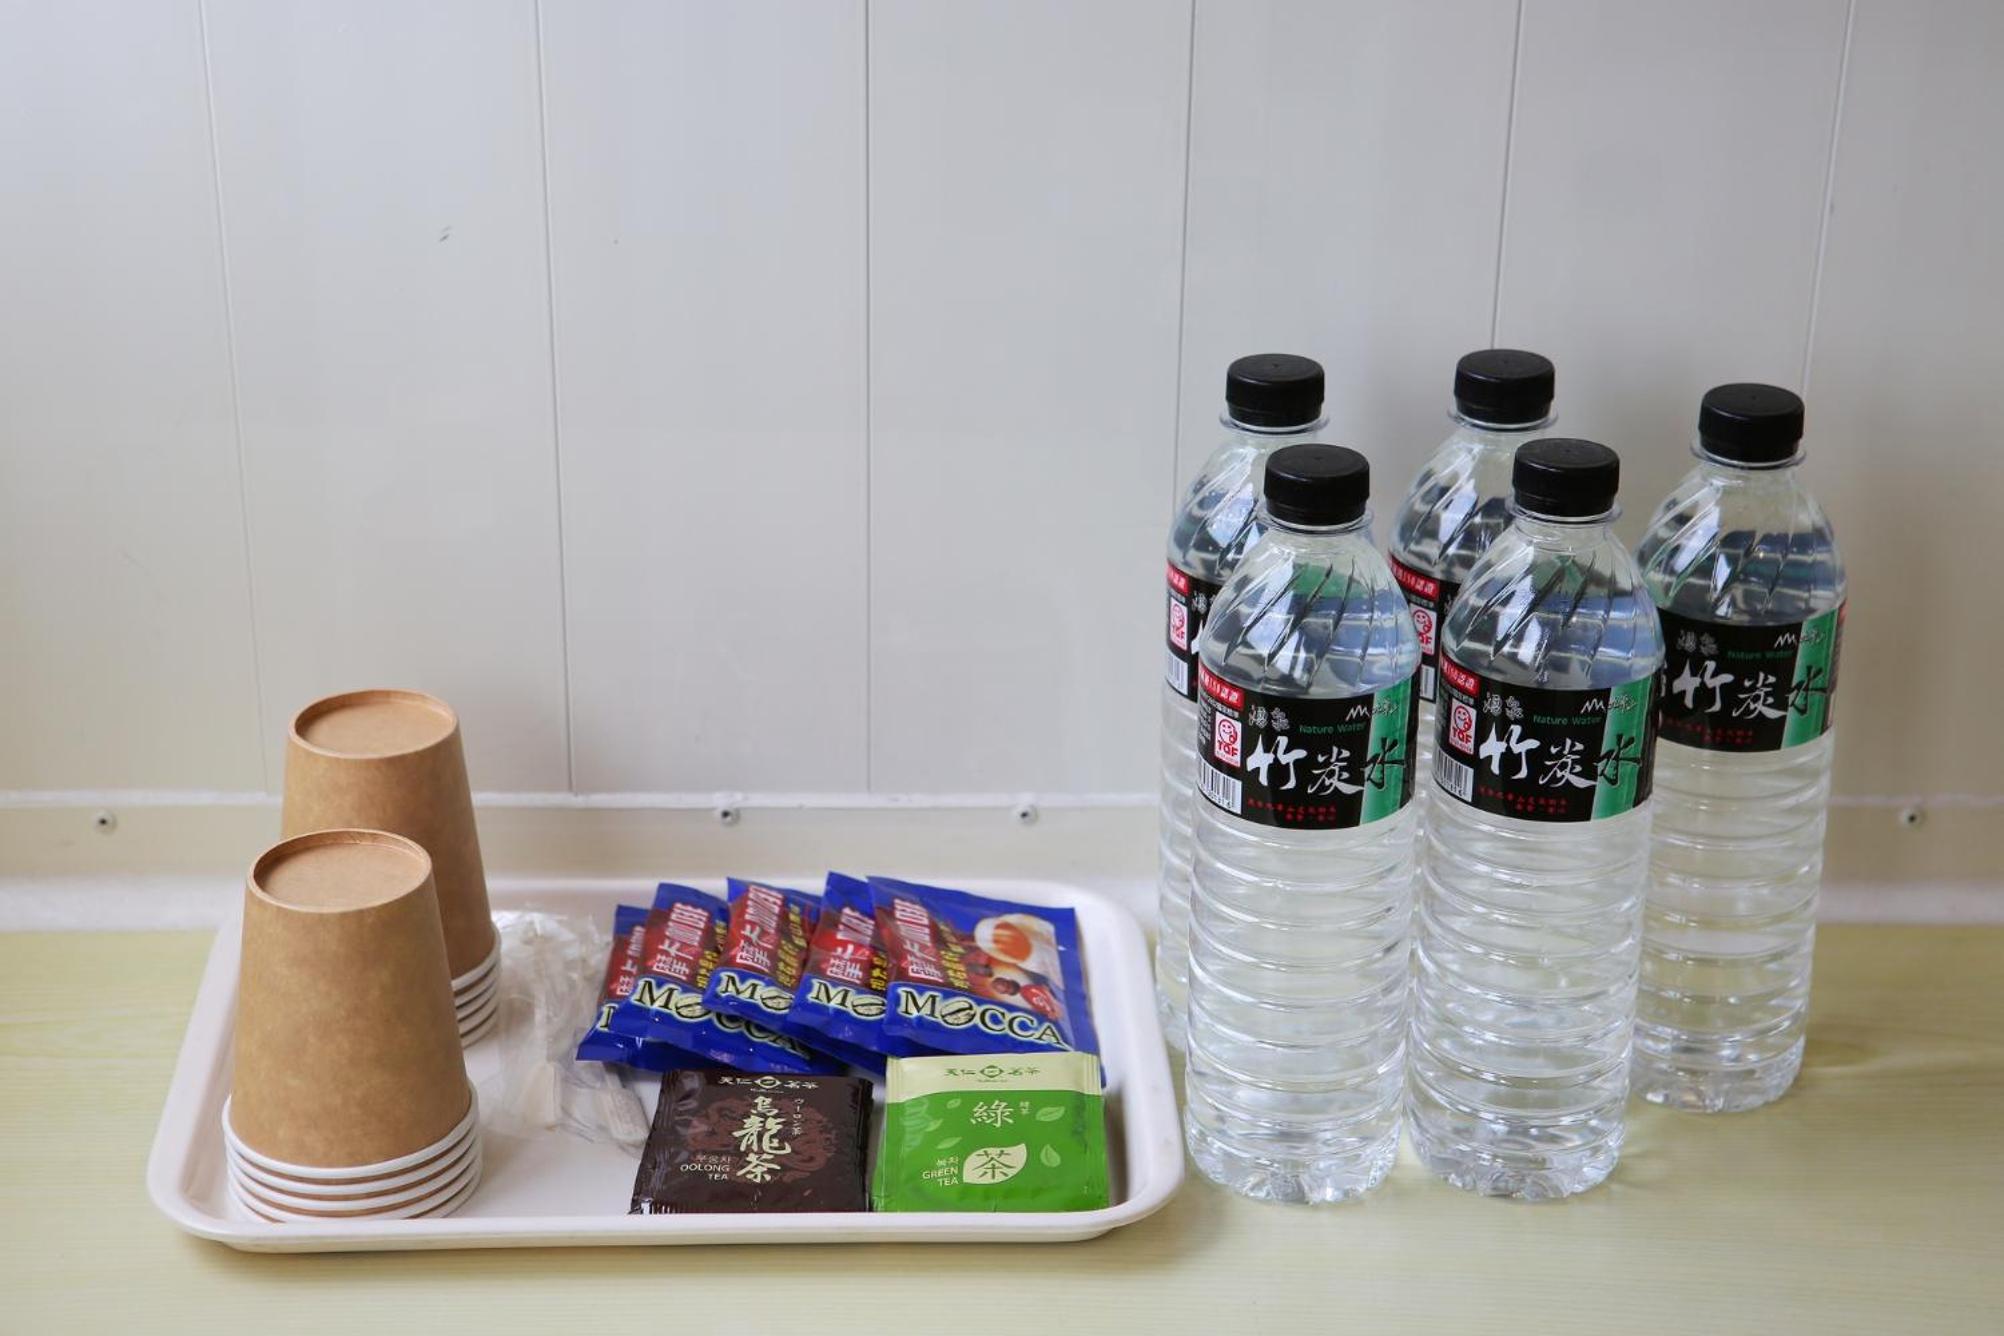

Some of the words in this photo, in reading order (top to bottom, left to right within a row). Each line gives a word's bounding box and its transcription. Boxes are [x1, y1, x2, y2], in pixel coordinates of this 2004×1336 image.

[1672, 659, 1828, 720] 竹炭水
[1533, 714, 1568, 725] Nature
[1571, 714, 1602, 725] Water
[1299, 724, 1334, 735] Nature
[1337, 721, 1367, 734] Water
[1479, 722, 1642, 788] 竹炭水
[1246, 733, 1406, 796] 竹炭水
[900, 988, 1074, 1051] MOCCA
[733, 1096, 792, 1183] 烏龍茶
[679, 1163, 731, 1173] OOLONG
[922, 1166, 959, 1180] GREEN
[708, 1172, 729, 1181] TEA
[936, 1175, 959, 1188] TEA
